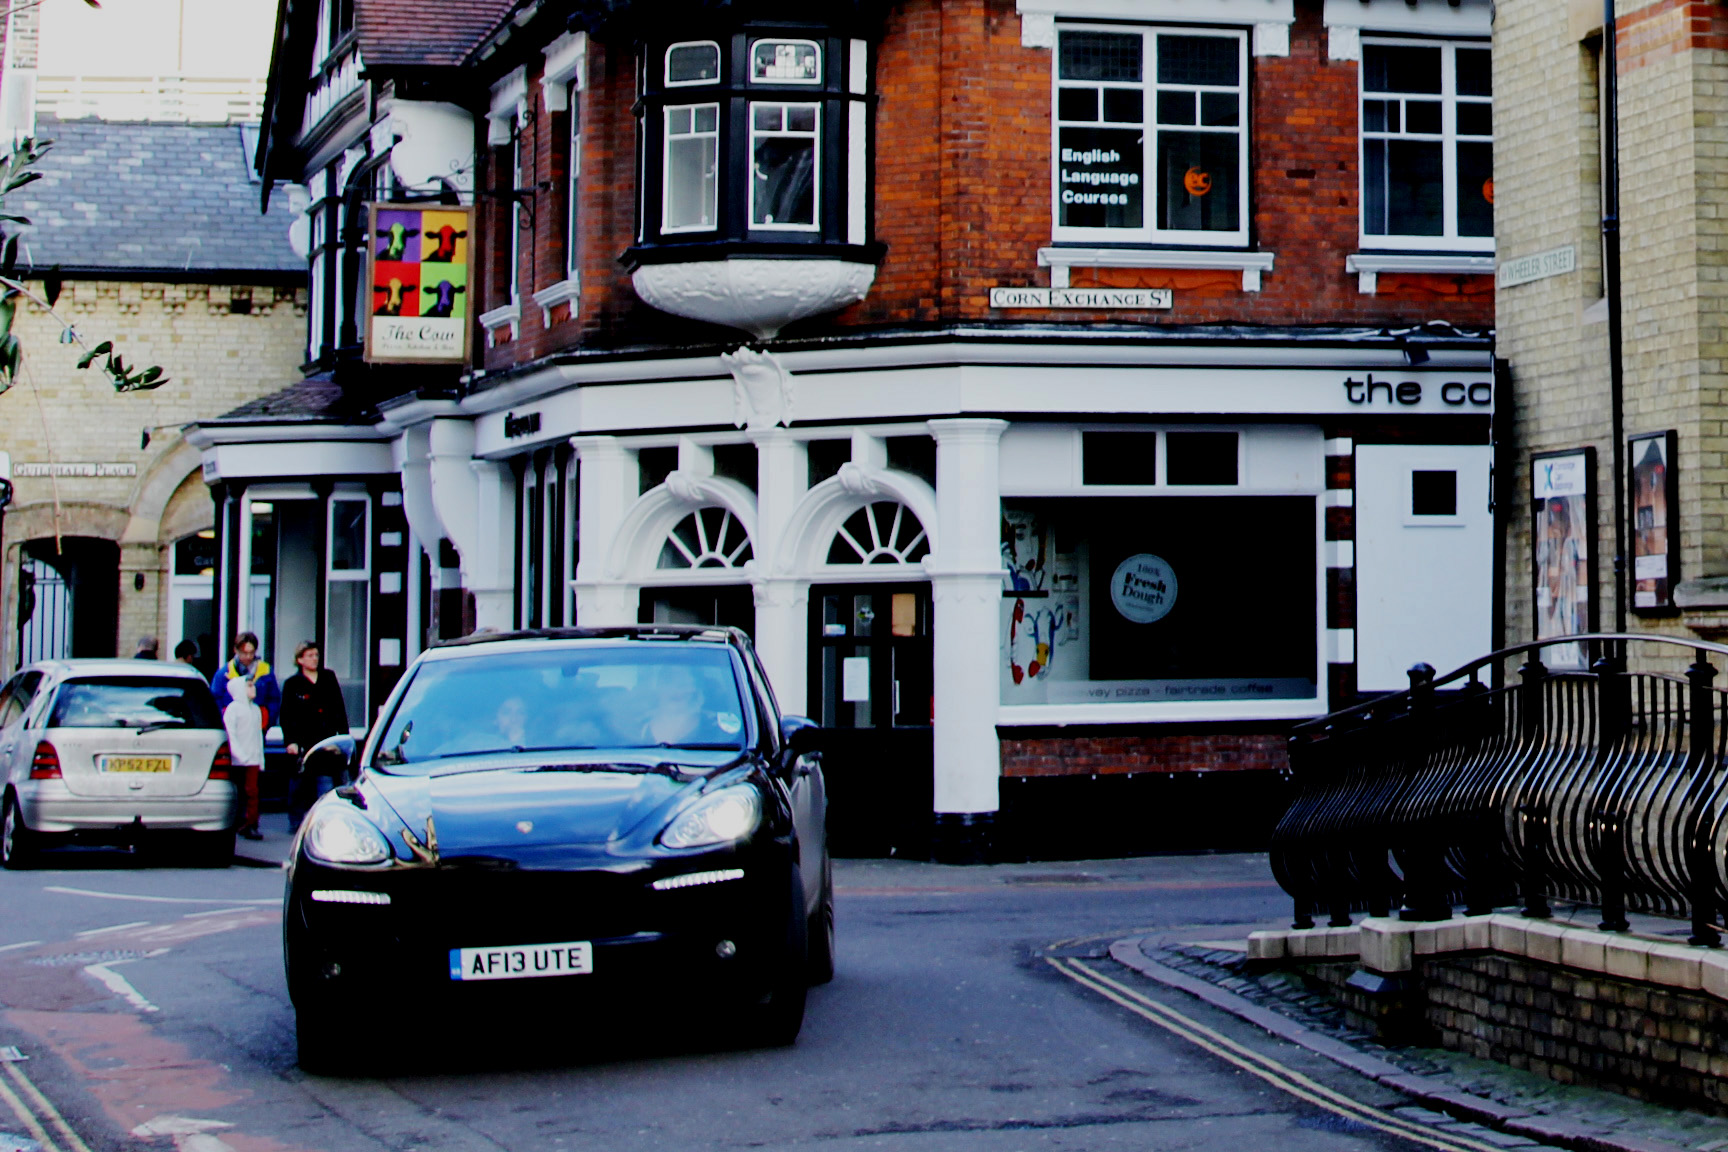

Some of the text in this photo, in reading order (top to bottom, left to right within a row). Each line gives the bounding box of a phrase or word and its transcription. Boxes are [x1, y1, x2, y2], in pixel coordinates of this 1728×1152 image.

[1062, 148, 1120, 165] English
[1062, 169, 1139, 187] Language
[1062, 189, 1128, 205] Courses
[1507, 249, 1572, 280] WHEELER STREET
[994, 289, 1042, 305] CORN
[1049, 289, 1145, 307] EXCHANGE
[382, 325, 455, 342] The Cow
[1343, 373, 1491, 405] the co
[97, 462, 134, 476] PLACE
[1125, 572, 1167, 594] Fresh
[1122, 584, 1164, 605] Dough
[1116, 686, 1150, 697] pizza
[1165, 684, 1226, 695] fairtrade
[1231, 682, 1273, 694] coffee
[472, 948, 582, 974] AF13 UTE
